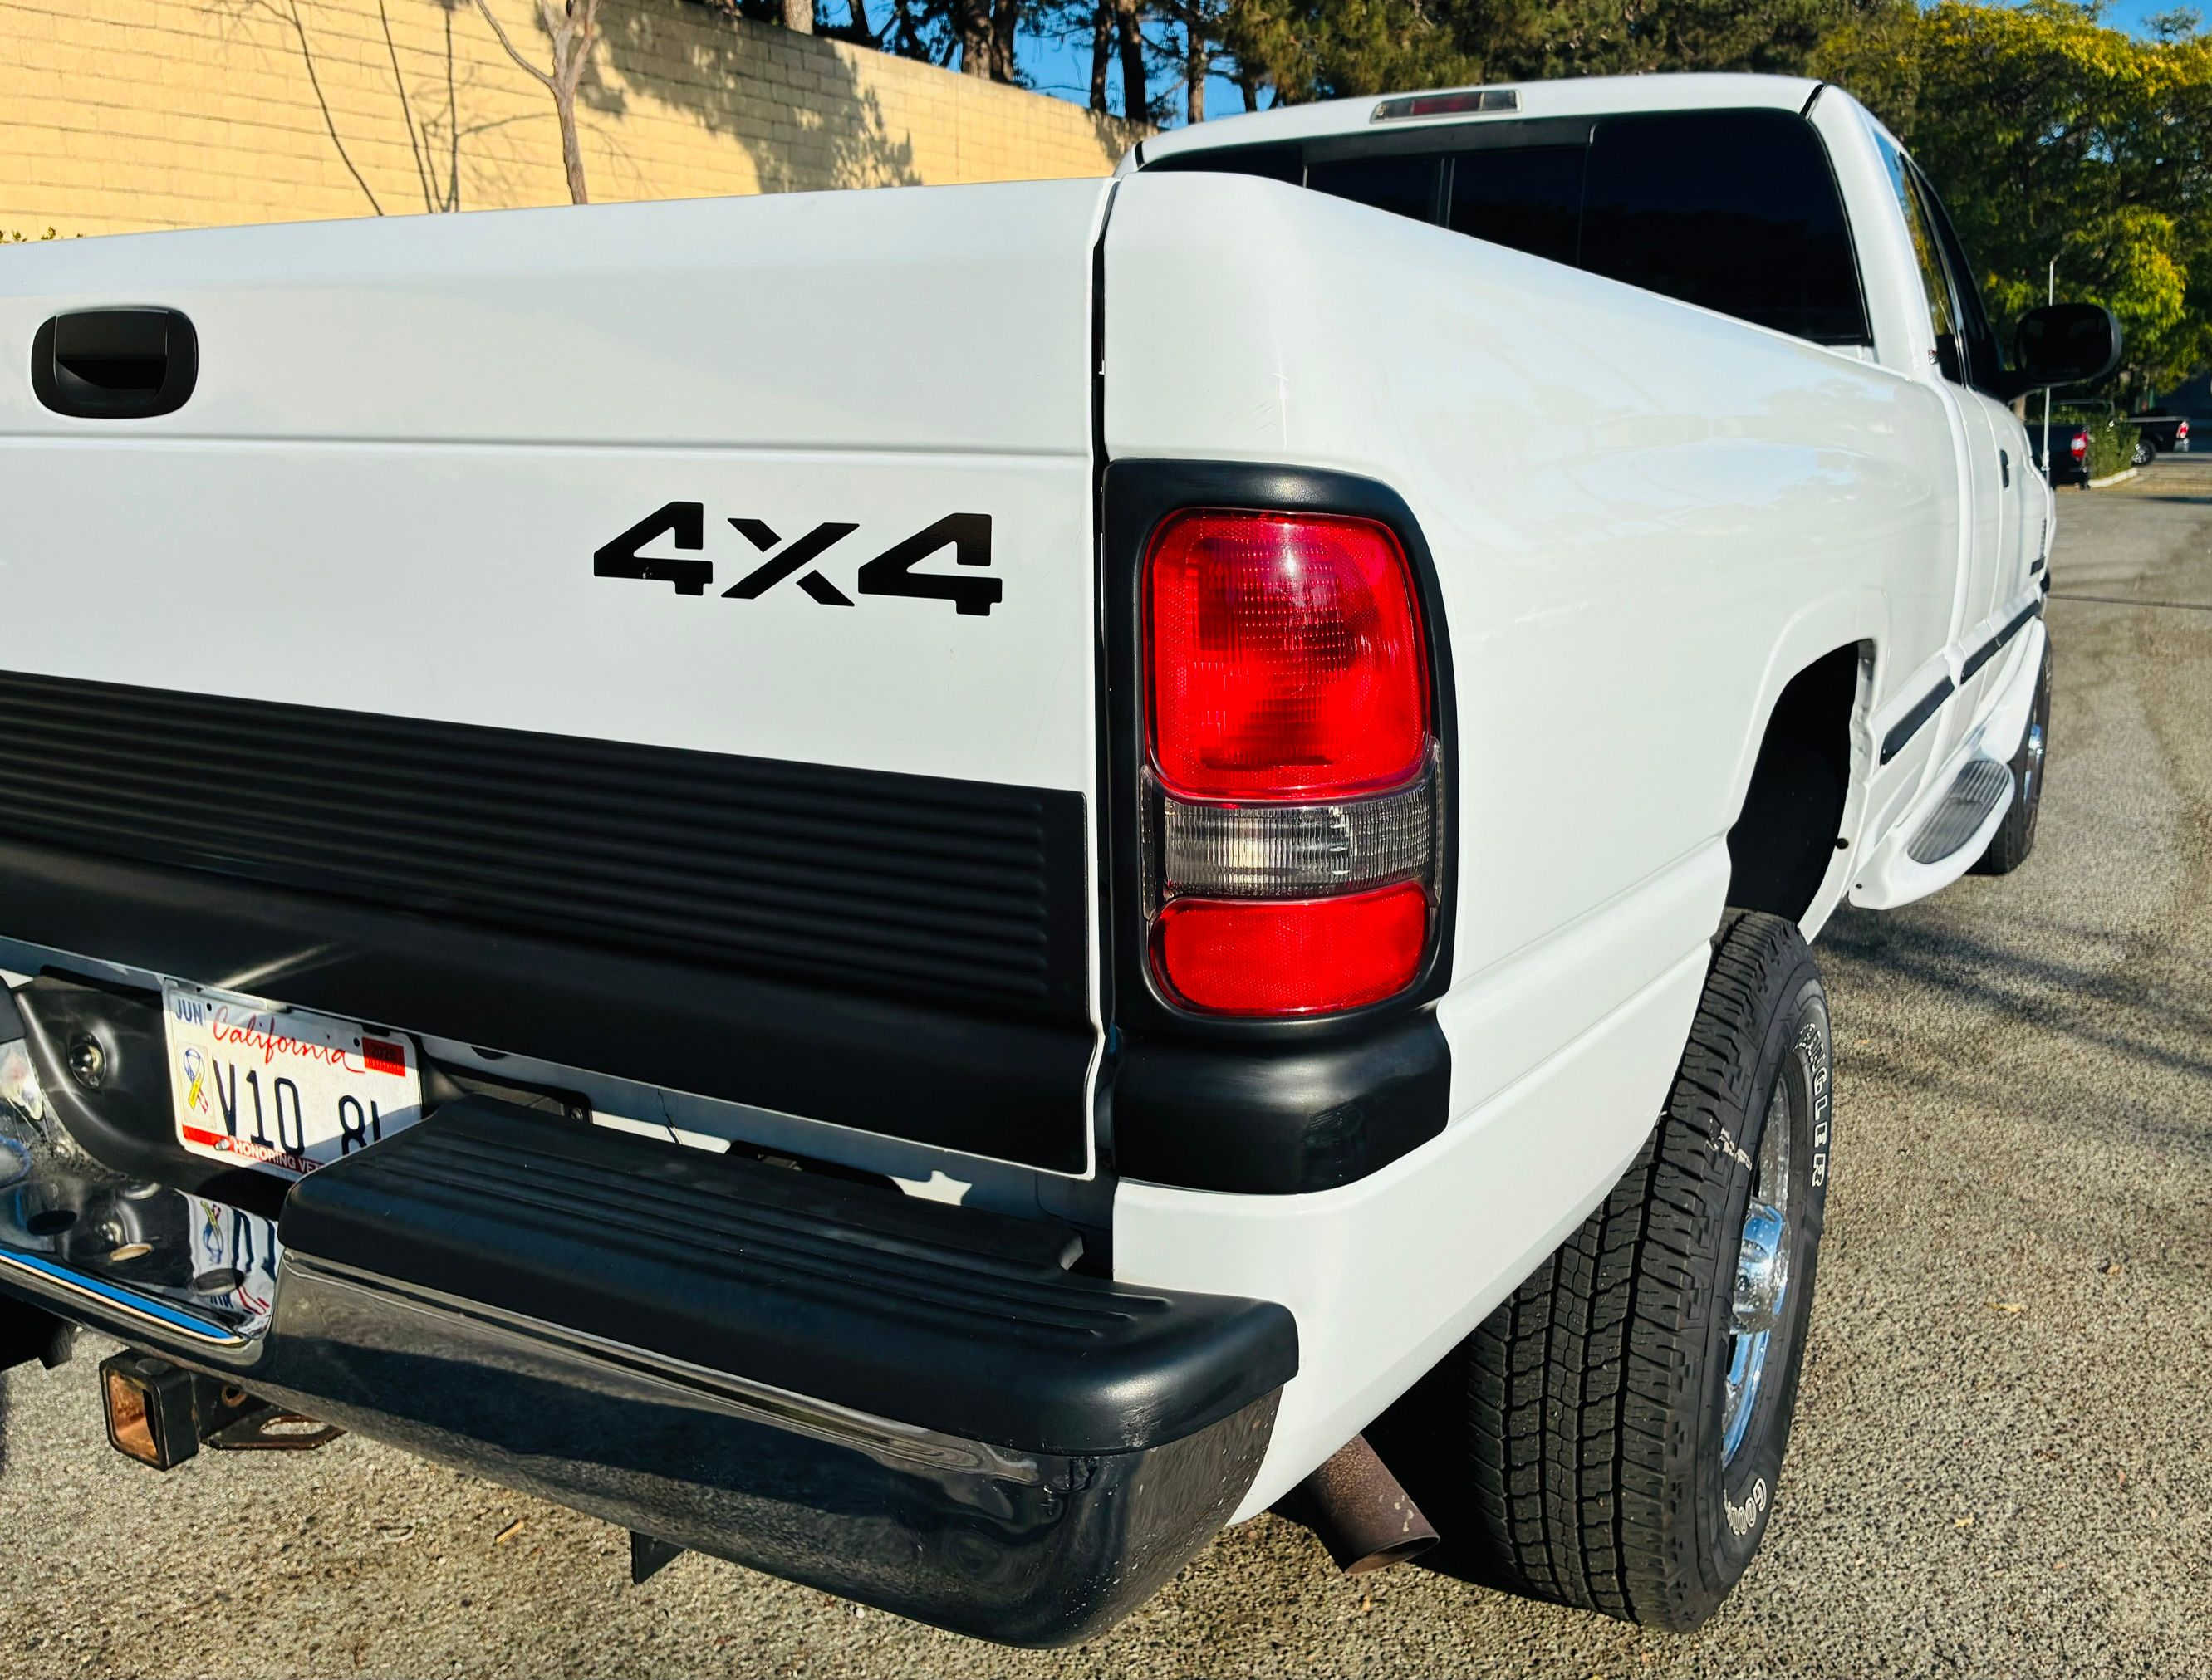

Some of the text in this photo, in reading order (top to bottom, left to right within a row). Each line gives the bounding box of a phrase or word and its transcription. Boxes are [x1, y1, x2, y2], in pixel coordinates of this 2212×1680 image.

[175, 998, 204, 1026] JUN
[213, 1005, 366, 1074] California
[212, 1056, 306, 1155] V10
[233, 1139, 297, 1170] HONORING
